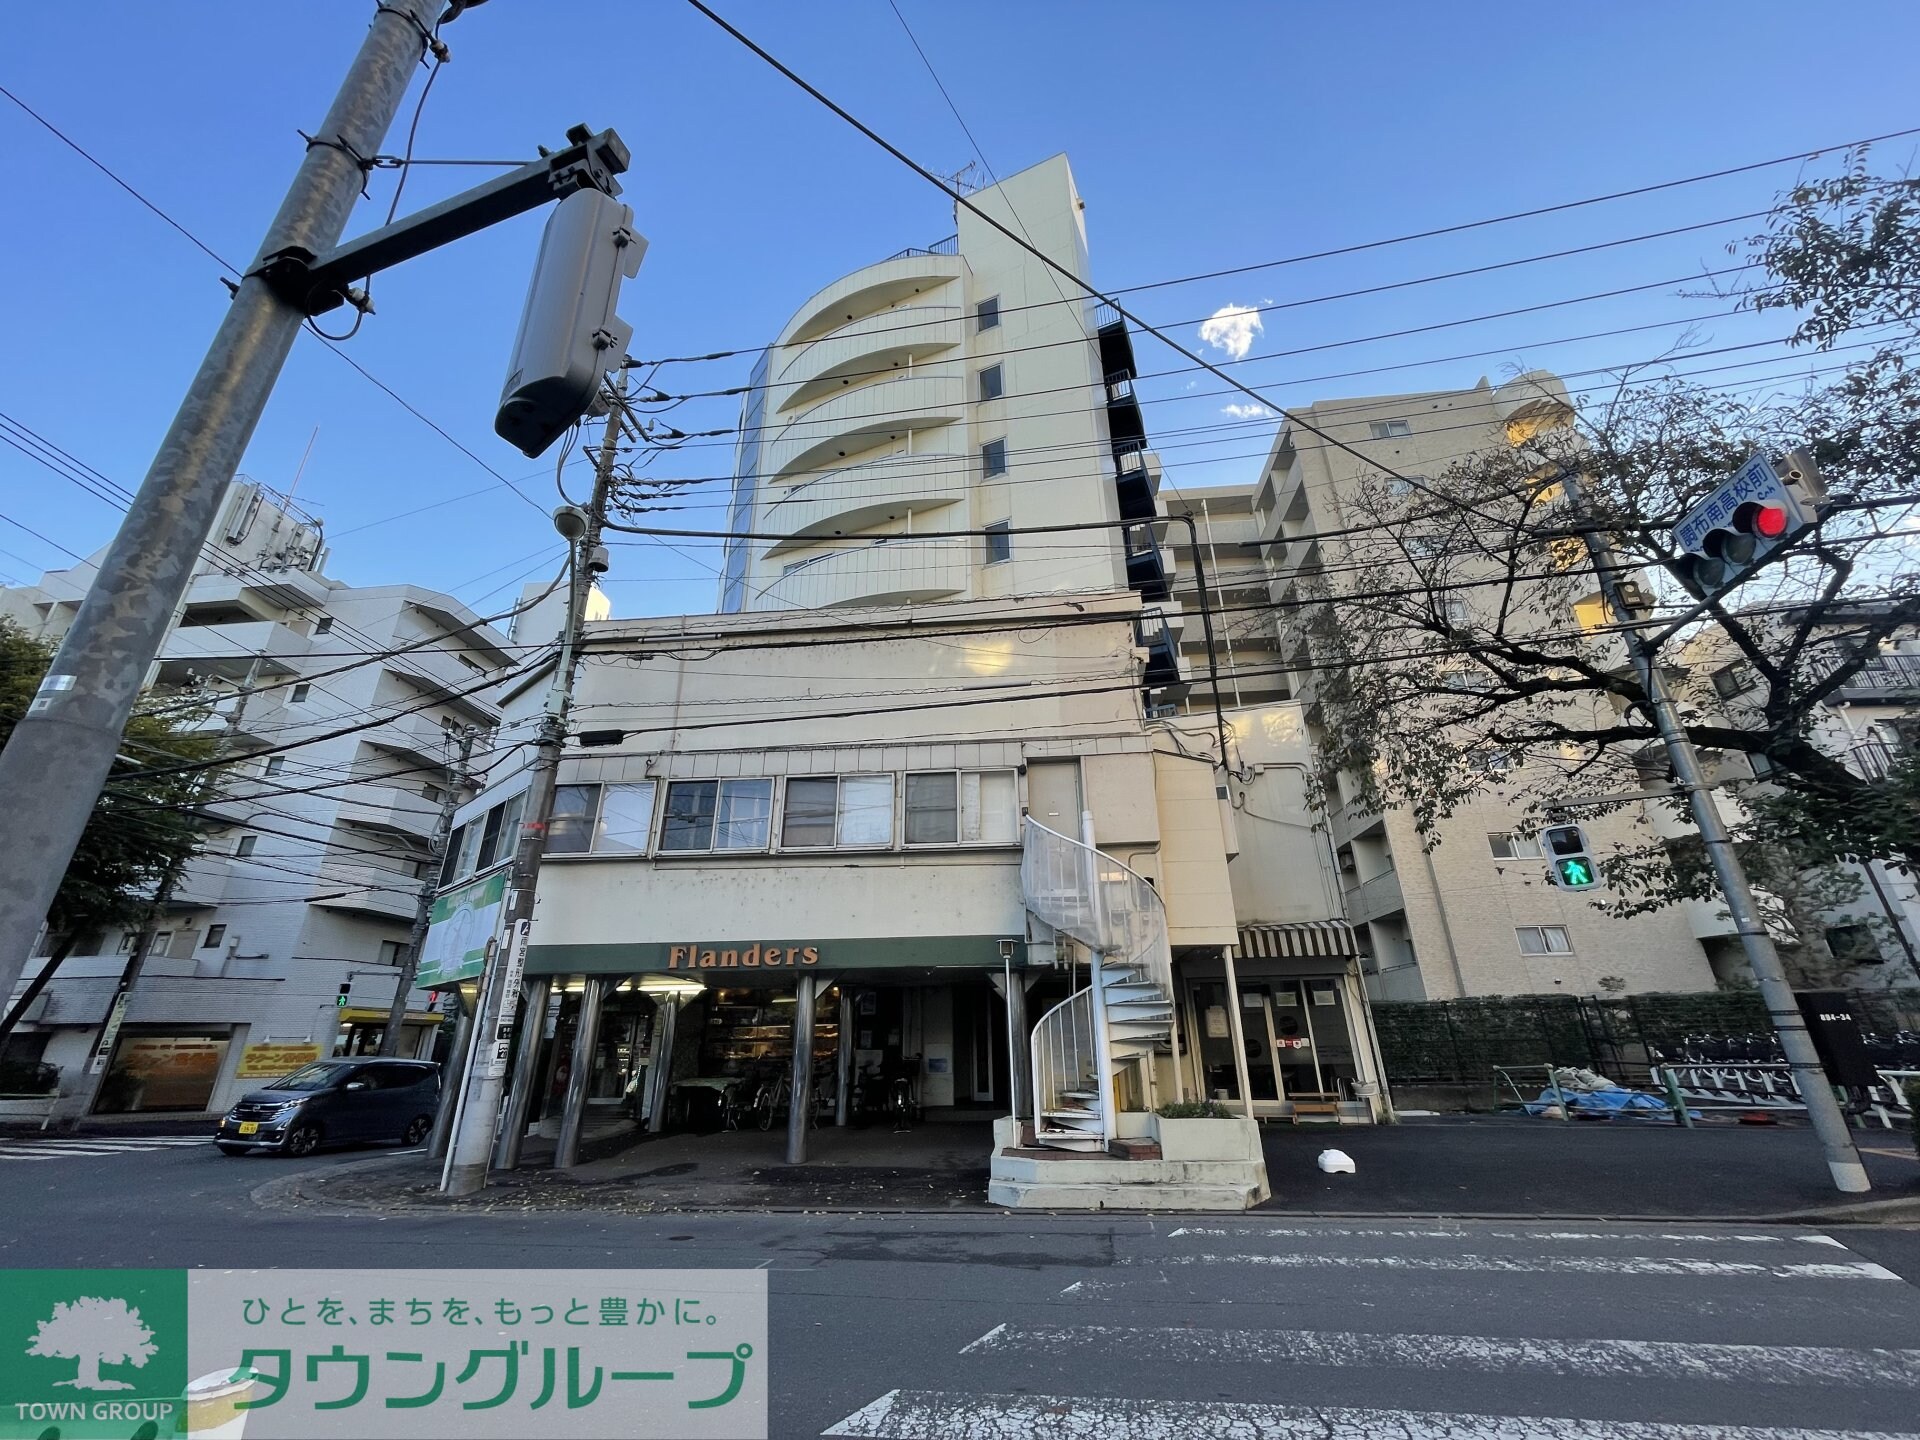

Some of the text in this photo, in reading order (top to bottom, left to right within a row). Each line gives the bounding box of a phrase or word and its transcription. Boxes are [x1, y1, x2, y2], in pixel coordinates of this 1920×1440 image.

[1680, 462, 1768, 547] 調布南高校前
[668, 943, 819, 969] Flanders
